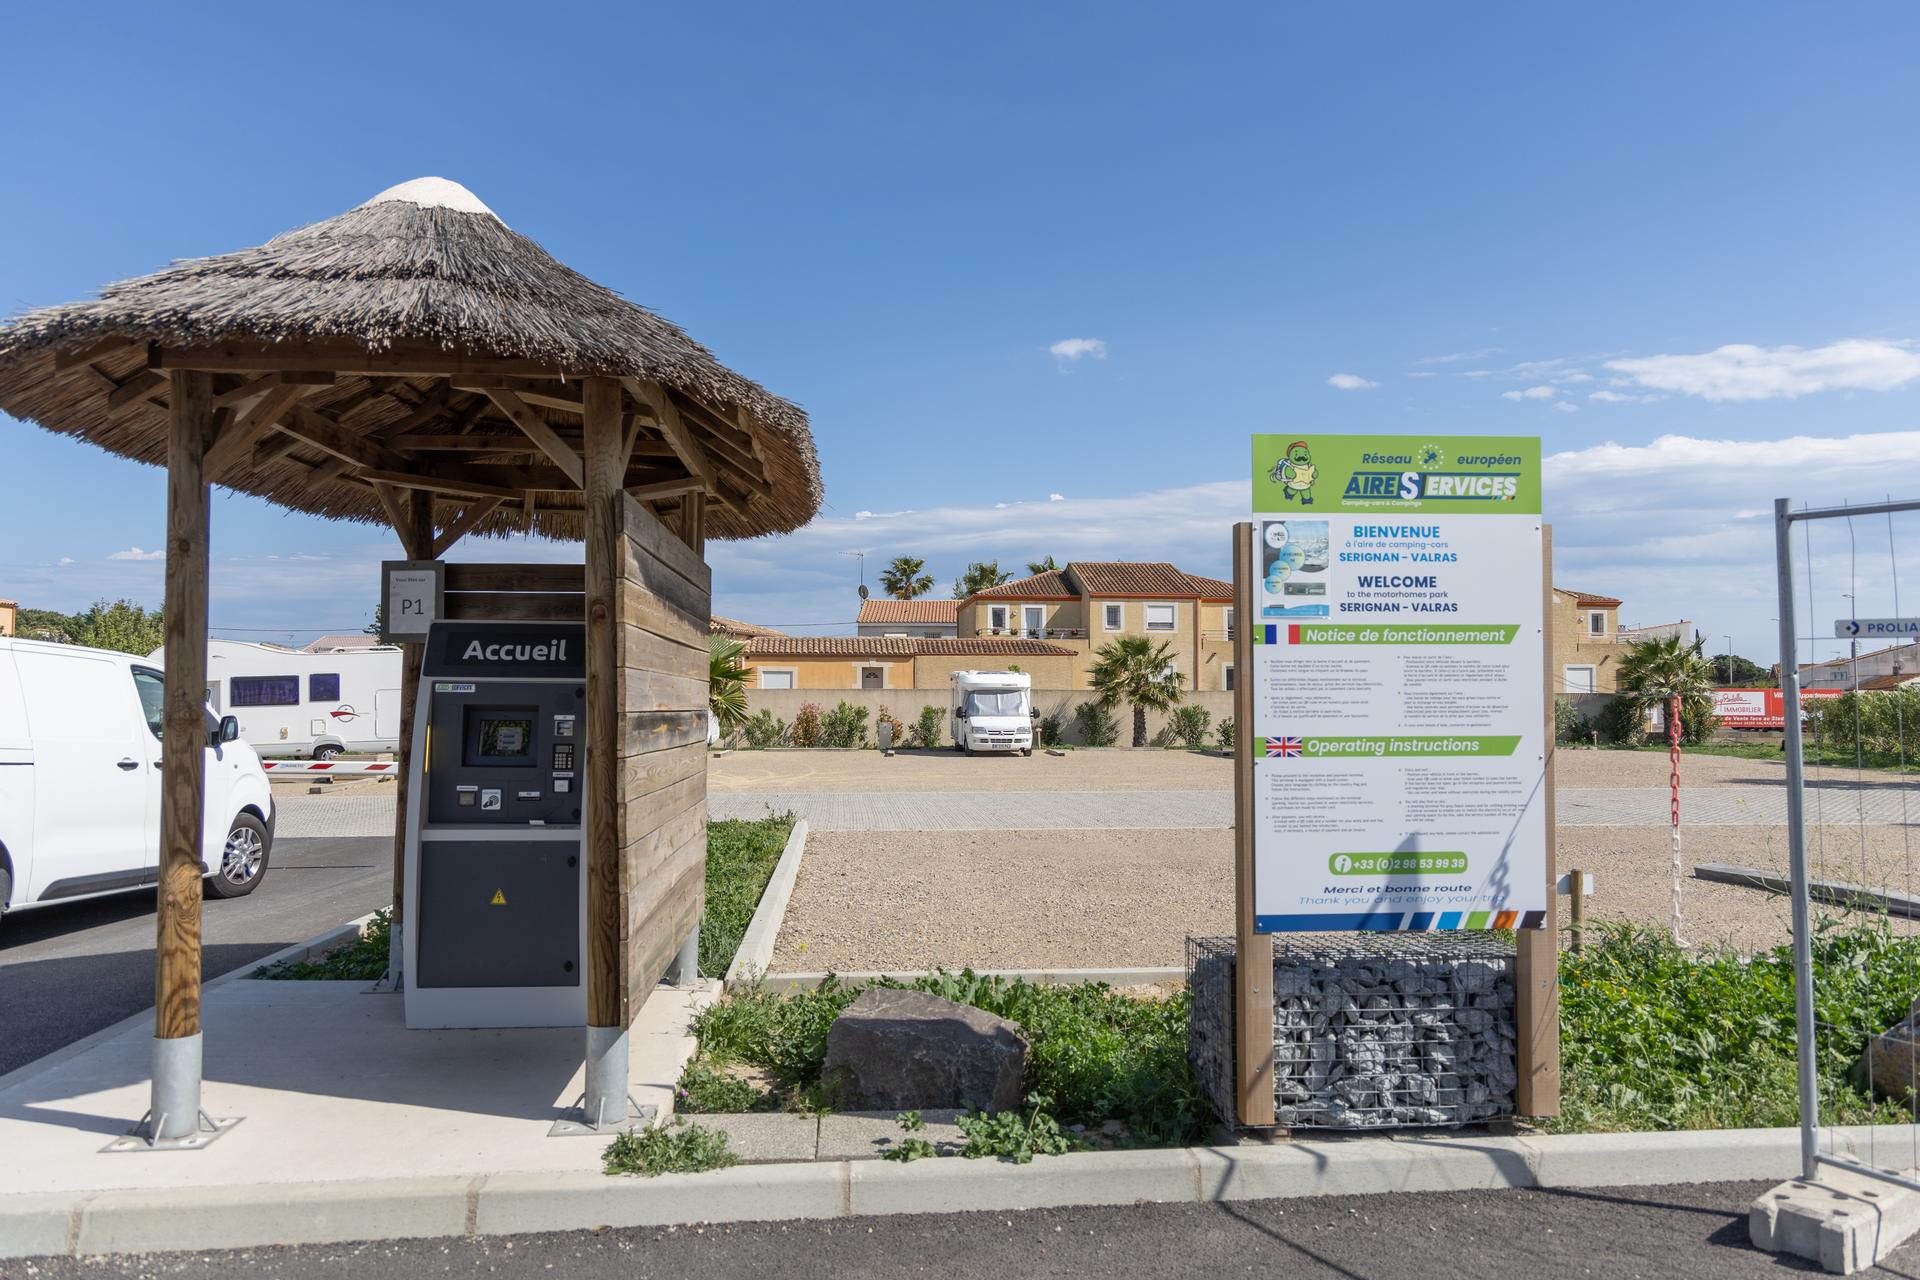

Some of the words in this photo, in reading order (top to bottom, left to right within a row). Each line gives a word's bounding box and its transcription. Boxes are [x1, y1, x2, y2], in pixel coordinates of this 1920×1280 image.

[1362, 452, 1412, 464] Réseau
[1457, 453, 1522, 468] européen
[1353, 526, 1440, 538] BIENVENUE
[1345, 540, 1351, 548] à
[1353, 540, 1373, 548] l'aire
[1389, 541, 1449, 550] camping-cars
[1339, 553, 1399, 562] SERIGNAN
[1411, 553, 1458, 562] VALRAS
[1358, 576, 1437, 588] WELCOME
[1429, 591, 1449, 600] park
[401, 599, 424, 615] P1
[1340, 603, 1400, 612] SERIGNAN
[1411, 603, 1459, 612] VALRAS
[1867, 622, 1920, 633] PROLIA
[1306, 628, 1356, 642] Notice
[1359, 628, 1379, 642] de
[1383, 628, 1506, 642] fonctionnement
[462, 639, 567, 661] Accueil
[1308, 738, 1386, 756] Operating
[1389, 738, 1480, 752] instructions
[1353, 859, 1375, 870] +33
[1376, 857, 1400, 872] (0)2
[1402, 858, 1417, 869] 98
[1420, 858, 1434, 869] 53
[1435, 858, 1450, 869] 99
[1451, 858, 1465, 868] 39
[1323, 885, 1365, 894] Merci
[1367, 886, 1381, 894] et
[1385, 885, 1431, 893] bonne
[1434, 884, 1472, 892] route
[1299, 896, 1341, 905] Thank
[1344, 897, 1370, 906] you
[1374, 895, 1402, 904] and
[1405, 894, 1444, 905] enjoy
[1448, 895, 1479, 904] your
